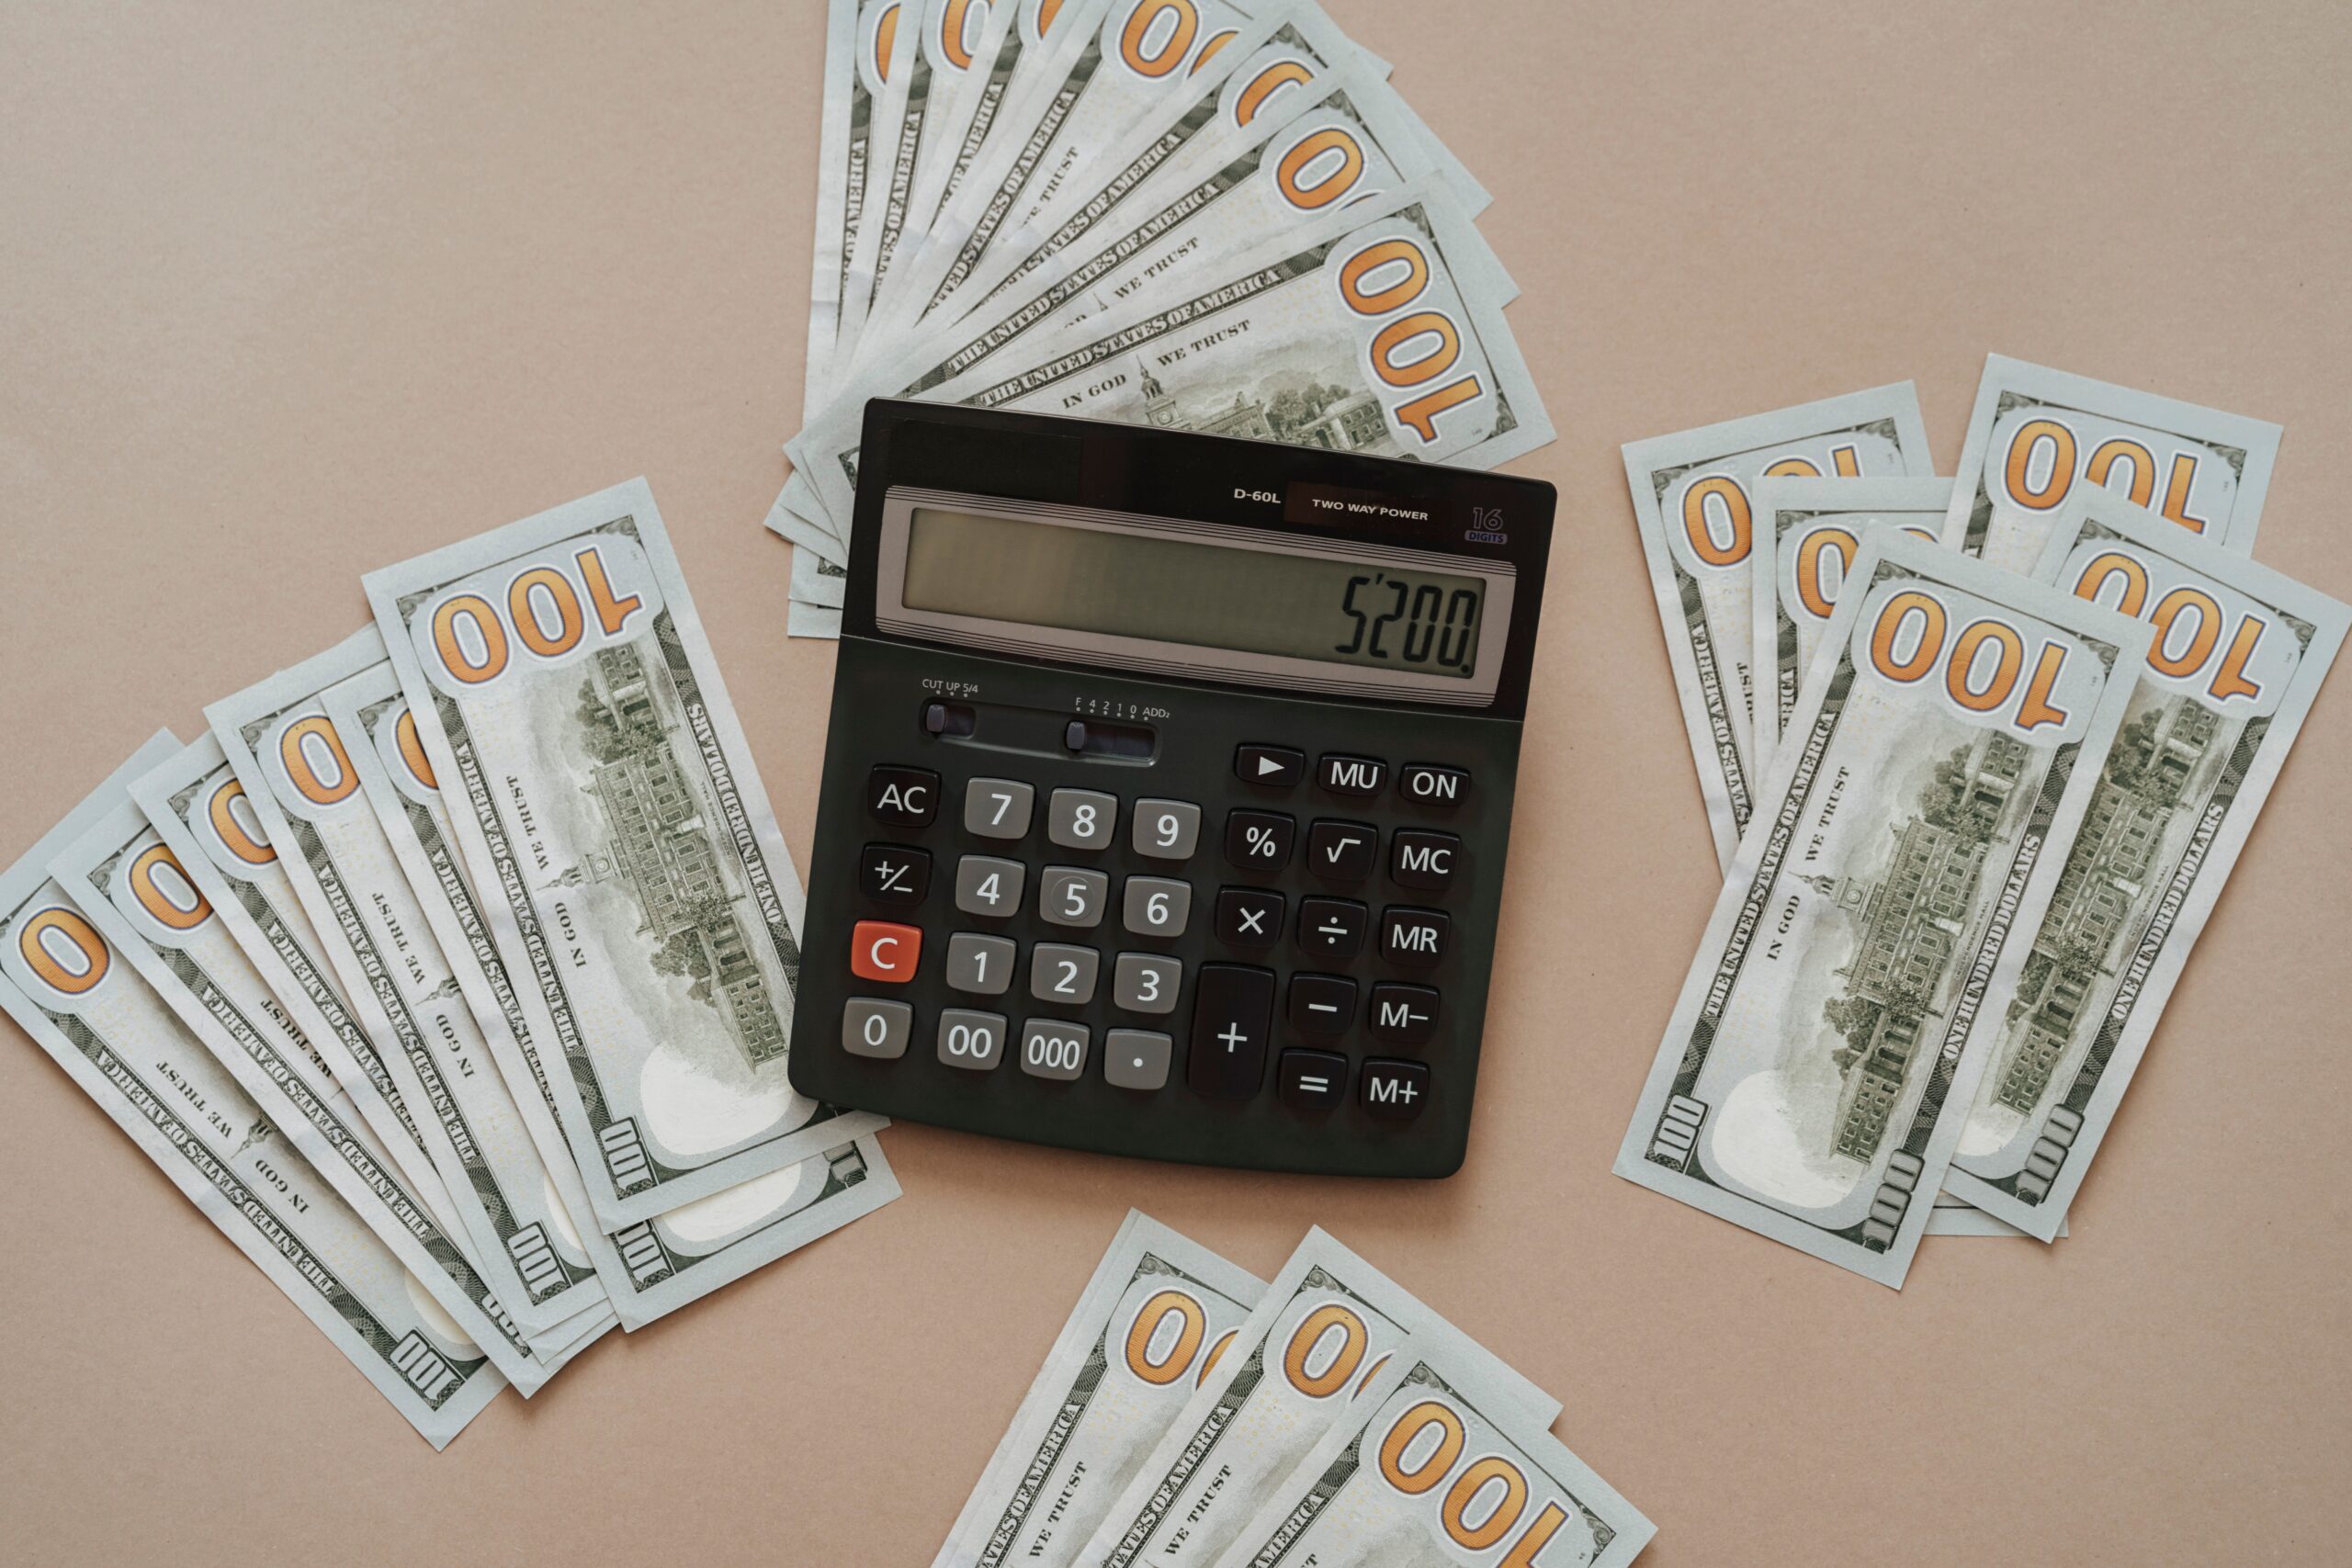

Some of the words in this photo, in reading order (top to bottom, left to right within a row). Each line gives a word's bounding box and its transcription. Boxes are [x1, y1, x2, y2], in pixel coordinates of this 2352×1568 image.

[956, 79, 1003, 173] AMERICA
[1003, 165, 1027, 195] OF
[1017, 87, 1075, 172] AMERICA
[891, 109, 920, 201] AMERICA
[1039, 146, 1080, 204] TRUST
[1084, 192, 1112, 219] OF
[1104, 129, 1181, 201] AMERICA
[845, 137, 865, 230] AMERICA
[886, 198, 902, 229] OF
[948, 339, 989, 372] THE
[983, 296, 1050, 348] UNITED
[1045, 249, 1119, 306] STATES
[1114, 232, 1143, 258] OF
[1135, 179, 1220, 243] AMERICA
[1114, 276, 1142, 299] WE
[1142, 236, 1202, 280] TRUST
[979, 378, 1022, 406] THE
[1020, 347, 1093, 389] UNITED
[1090, 315, 1169, 358] STATES
[1166, 304, 1194, 326] OF
[1189, 266, 1281, 316] AMERICA
[1340, 238, 1483, 444] 100
[1062, 391, 1084, 409] IN
[1087, 371, 1127, 399] GOD
[1158, 345, 1187, 368] WE
[1190, 316, 1252, 355] TRUST
[1234, 489, 1281, 503] D-60L
[1312, 499, 1343, 510] TWO
[1348, 502, 1378, 514] WAY
[1380, 507, 1429, 520] POWER
[1472, 507, 1505, 531] 16
[1468, 532, 1505, 543] DIGITS
[429, 545, 644, 686] 100
[1690, 622, 1725, 716] AMERICA
[1871, 591, 2070, 731] 100
[922, 679, 944, 691] CUT
[946, 682, 960, 692] UP
[963, 683, 978, 693] 5/4
[1076, 697, 1082, 706] F
[1089, 699, 1096, 708] 4
[1102, 701, 1110, 710] 2
[686, 700, 733, 794] DOLLARS
[1712, 714, 1732, 744] OF
[1330, 761, 1378, 789] MU
[1789, 707, 1838, 803] AMERICA
[453, 740, 501, 837] AMERICA
[505, 773, 539, 836] TRUST
[877, 784, 927, 813] AC
[1412, 771, 1458, 799] ON
[990, 793, 1012, 826] 7
[1072, 805, 1096, 838] 8
[1156, 815, 1179, 847] 9
[1780, 797, 1802, 827] OF
[488, 831, 509, 859] OF
[530, 840, 550, 870] WE
[720, 788, 768, 887] HUNDRED
[1401, 845, 1451, 874] MC
[1750, 823, 1792, 901] STATES
[1766, 938, 1783, 961] IN
[1776, 894, 1801, 934] GOD
[1804, 833, 1825, 863] WE
[1816, 765, 1850, 829] TRUST
[316, 863, 372, 956] AMERICA
[428, 846, 483, 942] AMERICA
[497, 855, 537, 935] STATES
[756, 882, 783, 923] ONE
[977, 873, 1000, 905] 4
[1064, 883, 1088, 917] 5
[1146, 893, 1170, 925] 6
[2109, 977, 2142, 1021] ONE
[2128, 886, 2185, 983] HUNDRED
[2171, 800, 2226, 892] DOLLARS
[370, 889, 411, 952] TRUST
[553, 901, 578, 942] GOD
[1392, 924, 1438, 953] MR
[1721, 899, 1761, 976] UNITED
[266, 920, 333, 1008] AMERICA
[360, 950, 383, 978] OF
[403, 953, 426, 984] WE
[471, 935, 493, 963] OF
[526, 931, 566, 1009] UNITED
[570, 945, 587, 967] IN
[870, 937, 898, 970] C
[974, 951, 987, 983] 1
[1940, 1018, 1970, 1061] ONE
[1956, 921, 2007, 1021] HUNDRED
[1993, 832, 2041, 926] DOLLARS
[1054, 961, 1078, 994] 2
[1136, 969, 1160, 1001] 3
[1704, 974, 1732, 1017] THE
[198, 986, 276, 1067] AMERICA
[259, 995, 311, 1052] TRUST
[322, 1000, 347, 1028] OF
[373, 974, 420, 1051] STATES
[433, 1011, 463, 1054] GOD
[555, 1007, 581, 1048] THE
[864, 1014, 887, 1046] 0
[309, 1050, 334, 1077] WE
[948, 1024, 992, 1058] 00
[1028, 1034, 1080, 1070] 000
[93, 1048, 174, 1129] AMERICA
[155, 1057, 209, 1111] TRUST
[265, 1057, 291, 1084] OF
[411, 1047, 457, 1122] UNITED
[456, 1055, 475, 1078] IN
[1369, 1077, 1419, 1104] M+
[163, 1119, 190, 1146] OF
[207, 1110, 234, 1138] WE
[283, 1077, 348, 1145] STATES
[1654, 1095, 1708, 1168] 100
[447, 1119, 476, 1160] THE
[600, 1117, 656, 1192] 100
[2015, 1104, 2085, 1201] 100
[182, 1138, 249, 1205] STATES
[253, 1157, 288, 1194] GOD
[339, 1138, 401, 1203] UNITED
[287, 1192, 309, 1214] IN
[394, 1198, 431, 1236] THE
[1862, 1148, 1924, 1247] 100
[240, 1197, 305, 1262] UNITED
[297, 1255, 336, 1294] THE
[508, 1222, 571, 1297] 100
[389, 1328, 461, 1401] 100
[1010, 1488, 1033, 1518] OF
[1022, 1399, 1080, 1495] AMERICA
[1149, 1483, 1176, 1514] OF
[1165, 1400, 1233, 1491] AMERICA
[1028, 1528, 1052, 1559] WE
[1046, 1461, 1089, 1525] TRUST
[1163, 1526, 1190, 1558] WE
[1186, 1462, 1233, 1526] TRUST
